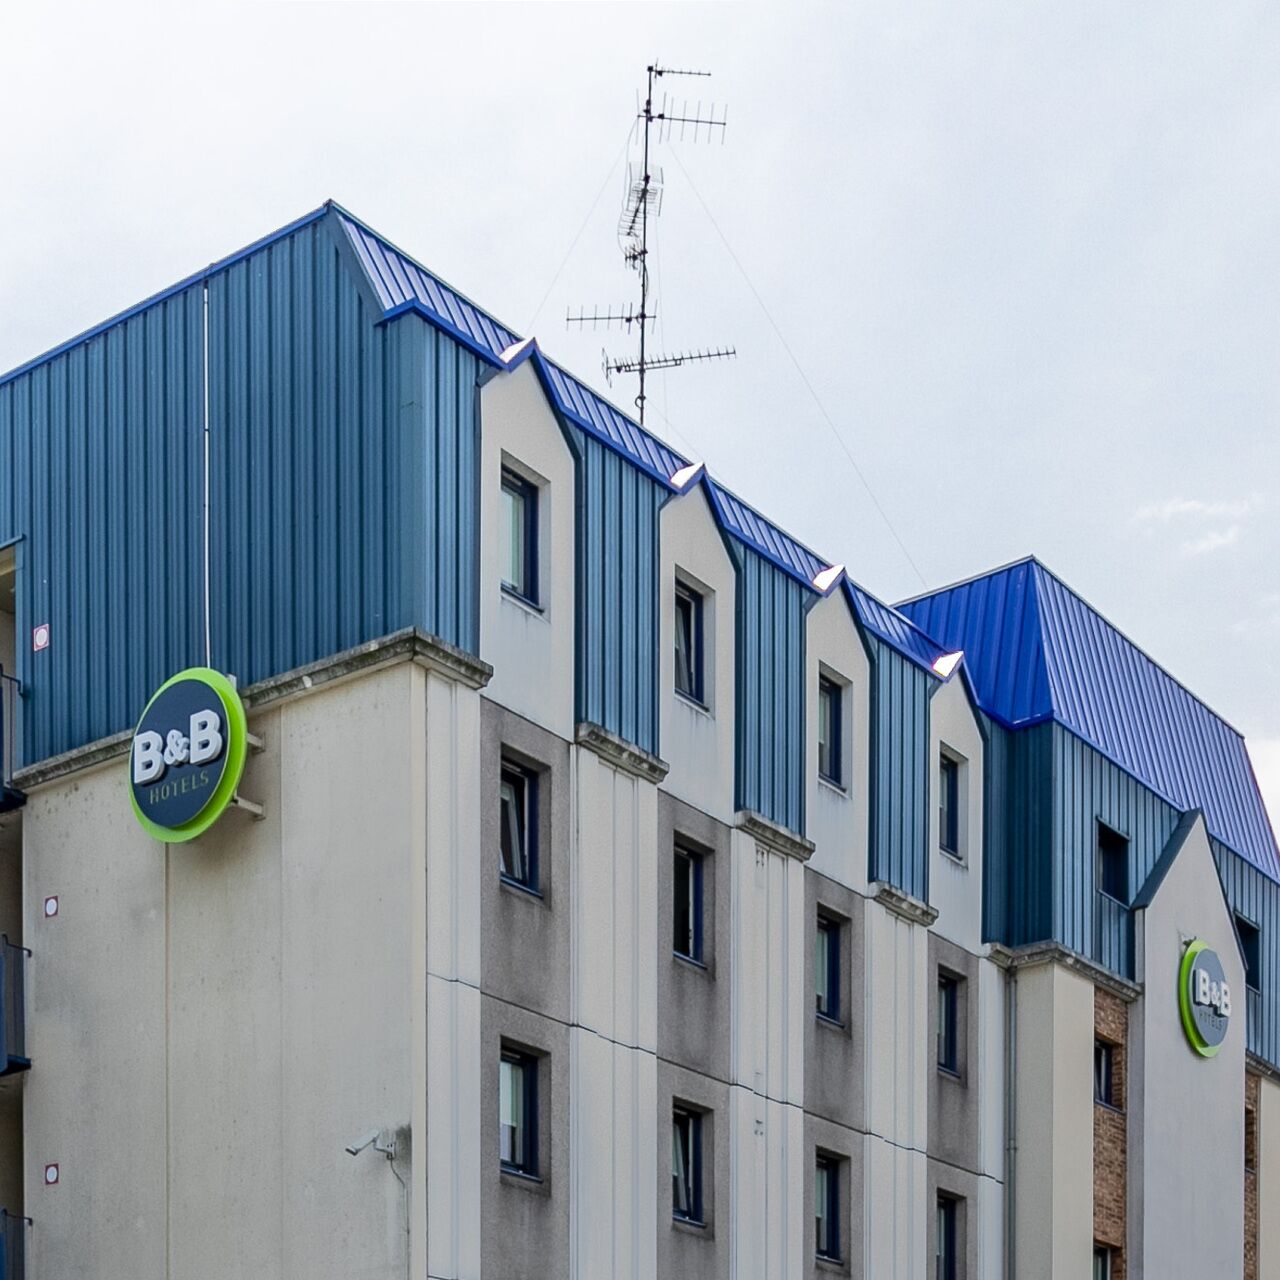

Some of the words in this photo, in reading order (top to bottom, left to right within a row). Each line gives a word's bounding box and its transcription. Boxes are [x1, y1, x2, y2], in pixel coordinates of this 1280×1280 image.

[134, 709, 223, 784] B&B
[150, 770, 210, 804] HOTELS
[1195, 968, 1232, 1017] B&B
